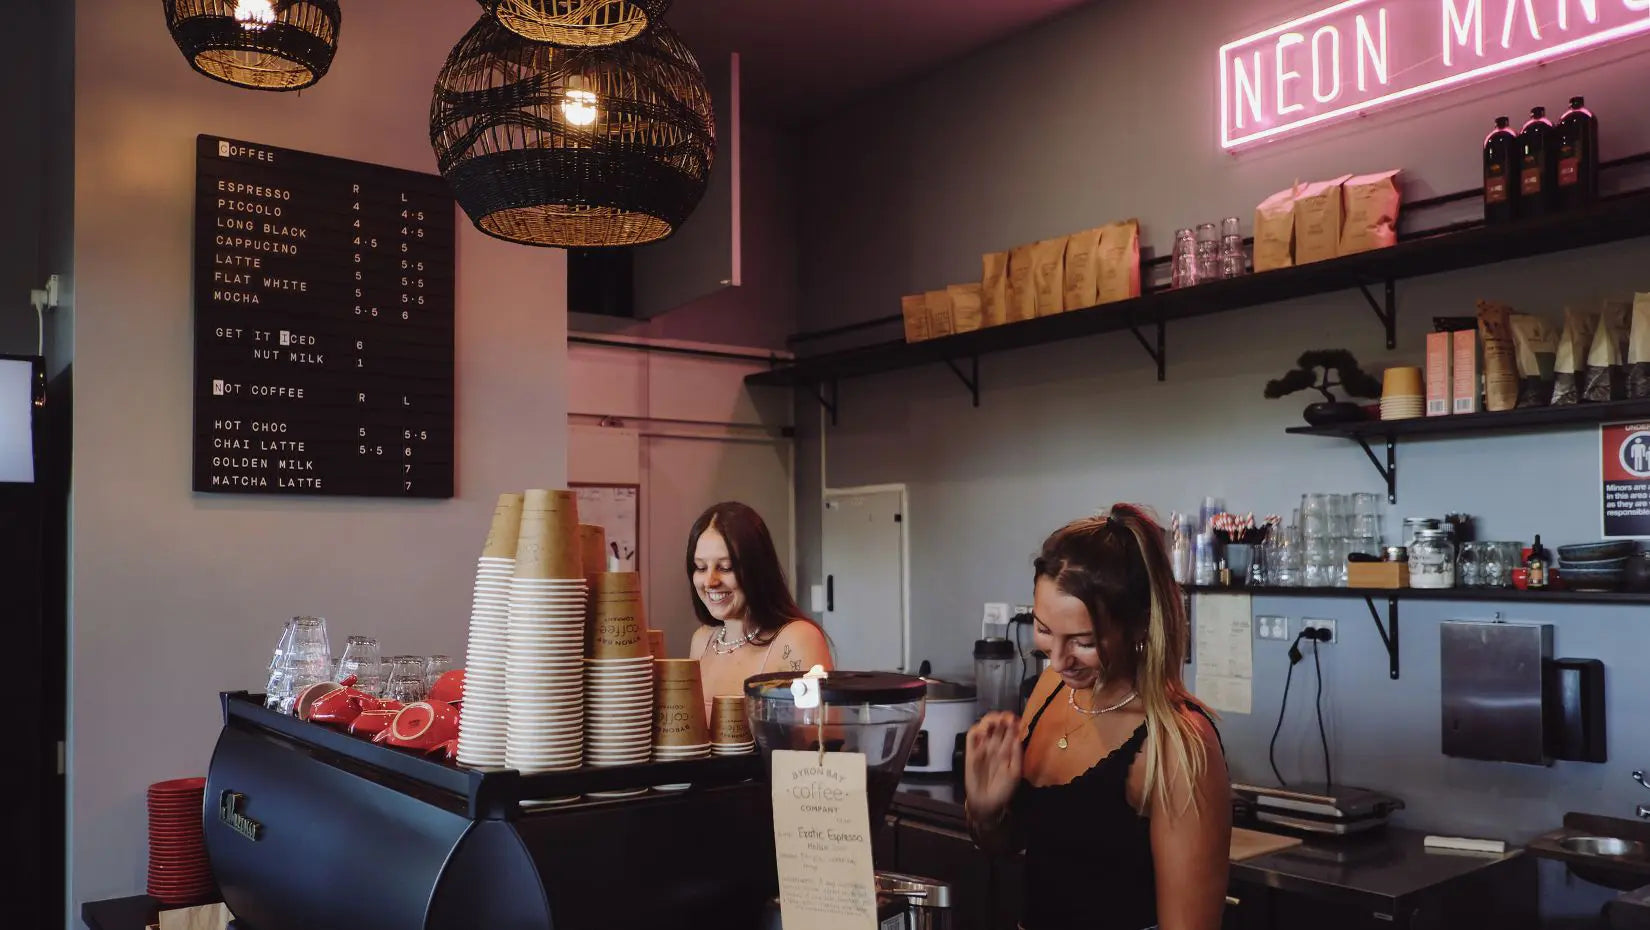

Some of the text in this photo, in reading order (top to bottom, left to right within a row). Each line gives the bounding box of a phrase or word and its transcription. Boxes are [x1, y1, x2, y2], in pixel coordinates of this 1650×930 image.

[1234, 0, 1650, 129] NEON MA
[219, 141, 274, 162] COFFEE
[219, 181, 289, 202] ESPRESSO
[354, 185, 359, 193] R
[218, 197, 281, 219] PICCOLO
[218, 218, 253, 230] LONG
[264, 224, 305, 237] BLACK
[402, 244, 407, 252] 5
[217, 234, 297, 256] CAPPUCINO
[355, 254, 360, 262] 5
[217, 255, 259, 267] LATTE
[216, 272, 250, 283] FLAT
[264, 279, 306, 291] WHITE
[356, 289, 361, 297] 5
[215, 291, 258, 303] MOCHA
[216, 328, 362, 349] GET IT ICED 6
[255, 350, 362, 367] NUT MILK 1
[213, 379, 409, 405] NOT COFFEE R L
[215, 421, 240, 430] HOT
[253, 422, 286, 432] CHOC
[360, 428, 365, 436] 5
[215, 439, 249, 449] CHAI
[262, 441, 304, 451] LATTE
[405, 448, 411, 456] 6
[213, 457, 267, 468] GOLDEN
[280, 460, 312, 469] MILK
[213, 476, 266, 486] MATCHA
[280, 478, 321, 488] LATTE
[1617, 500, 1633, 508] they
[792, 767, 824, 780] BYRON
[792, 781, 843, 801] coffee
[801, 804, 839, 814] COMPANY
[828, 829, 863, 843] Espresso
